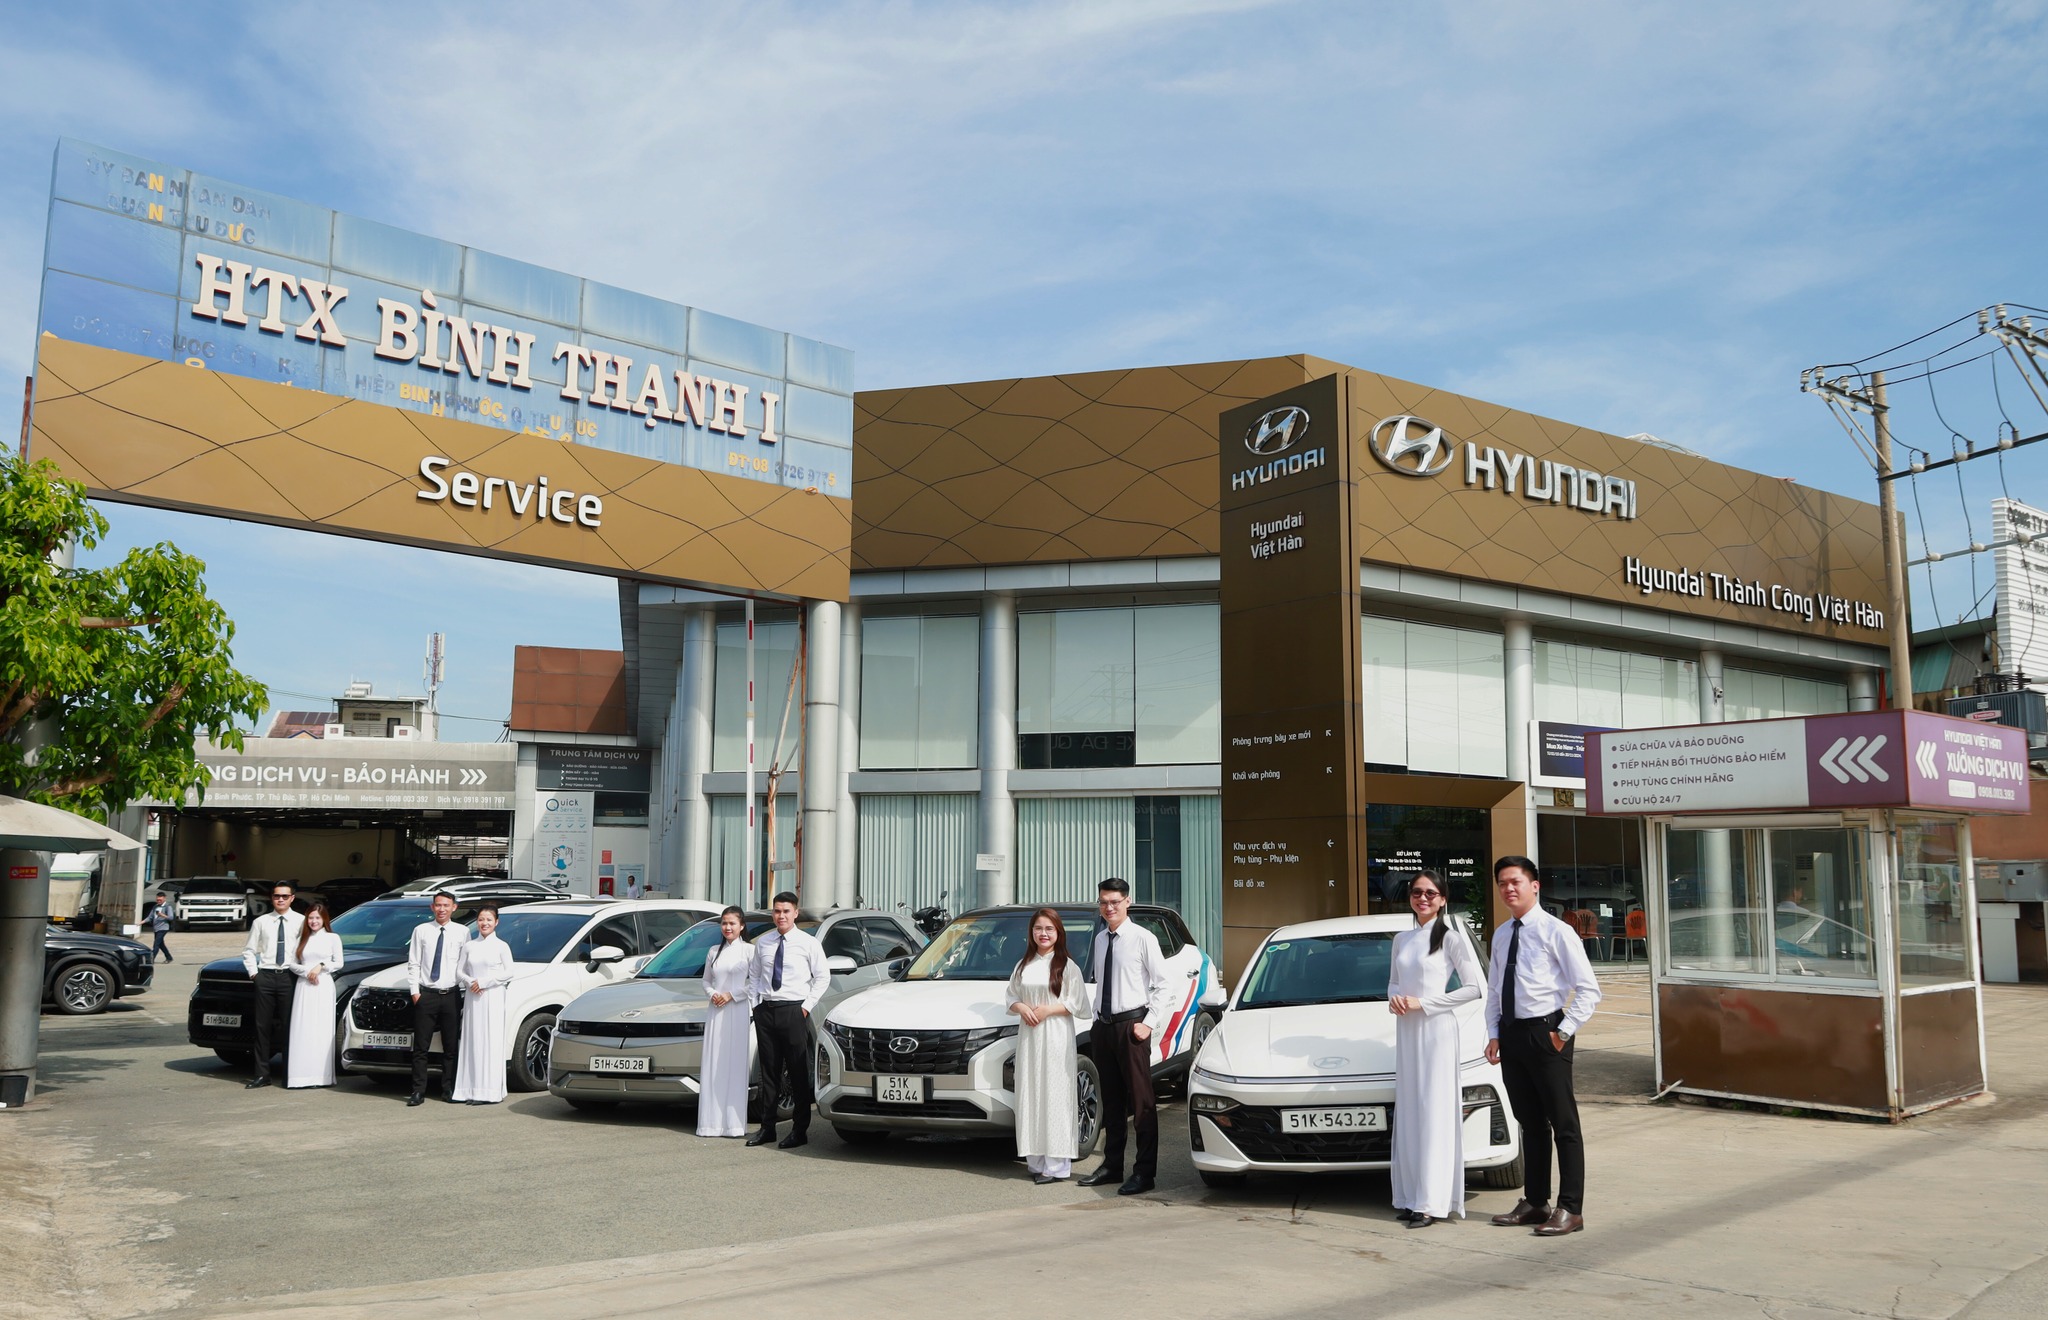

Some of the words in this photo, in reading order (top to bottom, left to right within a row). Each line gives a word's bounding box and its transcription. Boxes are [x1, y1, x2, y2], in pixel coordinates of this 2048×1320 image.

[121, 167, 165, 193] BAN
[192, 252, 349, 348] HTX
[374, 287, 536, 390] BÌNH
[552, 341, 749, 438] THẠNH
[758, 390, 780, 444] I
[752, 457, 769, 473] 08
[1231, 446, 1325, 491] HYUNDAI
[1464, 441, 1638, 520] HYUNDAI
[418, 455, 603, 527] Service
[1250, 511, 1303, 540] Hyundai
[1250, 541, 1276, 560] Việt
[1278, 535, 1303, 553] Hàn
[1624, 556, 1705, 595] Hyundai
[1710, 572, 1767, 607] Thành
[1771, 584, 1813, 622] Công
[1817, 593, 1851, 626] Việt
[1855, 600, 1884, 629] Hàn
[1232, 737, 1251, 747] Phòng
[1254, 736, 1272, 745] trưng
[1619, 741, 1638, 752] SỬA
[1639, 738, 1667, 750] CHỮA
[1668, 738, 1682, 749] VÀ
[1684, 736, 1705, 748] BẢO
[1706, 734, 1745, 746] DƯỠNG
[1944, 729, 1974, 746] HYUNDAI
[1973, 733, 1988, 751] VIỆT
[550, 750, 581, 758] TRUNG
[582, 749, 602, 758] TÂM
[604, 751, 626, 760] DỊCH
[627, 752, 640, 761] VỤ
[1620, 756, 1640, 769] TIẾP
[1641, 758, 1669, 771] NHẬN
[1690, 754, 1733, 766] THƯỜNG
[1735, 751, 1757, 763] BẢO
[1759, 748, 1787, 761] HIỂM
[241, 765, 293, 786] DỊCH
[297, 766, 327, 787] VỤ
[343, 762, 387, 783] BẢO
[391, 764, 450, 785] HÀNH
[1946, 746, 1985, 776] XƯỞNG
[1985, 757, 2009, 783] DỊCH
[2008, 761, 2023, 786] VỤ
[1620, 778, 1640, 789] PHỤ
[1641, 775, 1669, 786] TÙNG
[1670, 774, 1702, 785] CHÍNH
[546, 798, 579, 812] Quick
[1621, 794, 1642, 806] CỨU
[1643, 794, 1657, 807] HỘ
[1659, 795, 1681, 804] 24/7
[1233, 842, 1246, 851] Khu
[1247, 842, 1260, 852] vực
[1278, 842, 1287, 851] vụ
[1233, 855, 1246, 865] Phụ
[1269, 854, 1283, 864] Phụ
[1284, 854, 1299, 863] kiện
[1256, 880, 1265, 888] xe
[594, 1059, 644, 1070] 51H-450.28
[889, 1077, 909, 1089] 51K
[882, 1089, 918, 1102] 463.44
[1290, 1112, 1377, 1128] 51K-543.22
